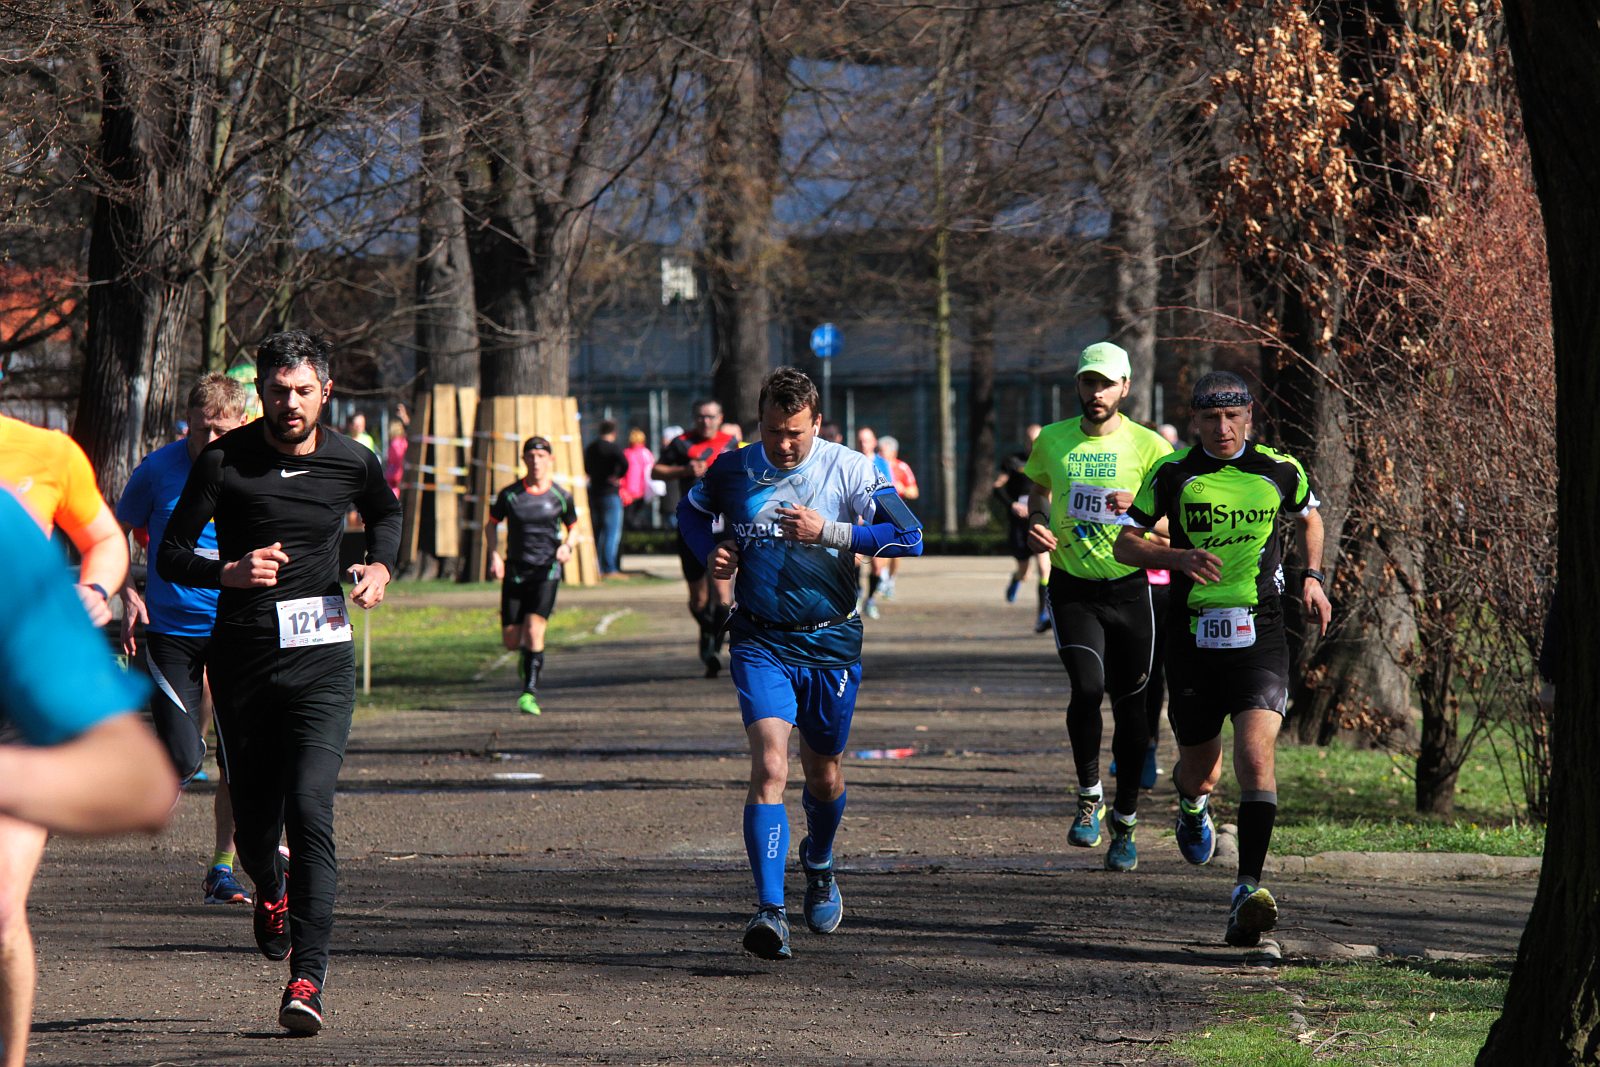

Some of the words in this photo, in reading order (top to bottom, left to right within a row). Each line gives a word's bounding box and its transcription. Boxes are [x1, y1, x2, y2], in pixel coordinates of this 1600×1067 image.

[1068, 452, 1117, 463] RUNNERS
[1084, 468, 1116, 478] BIEG
[1073, 492, 1102, 513] 015
[1200, 534, 1257, 549] team
[288, 610, 321, 635] 121
[1202, 619, 1232, 638] 150
[767, 823, 781, 859] TODO
